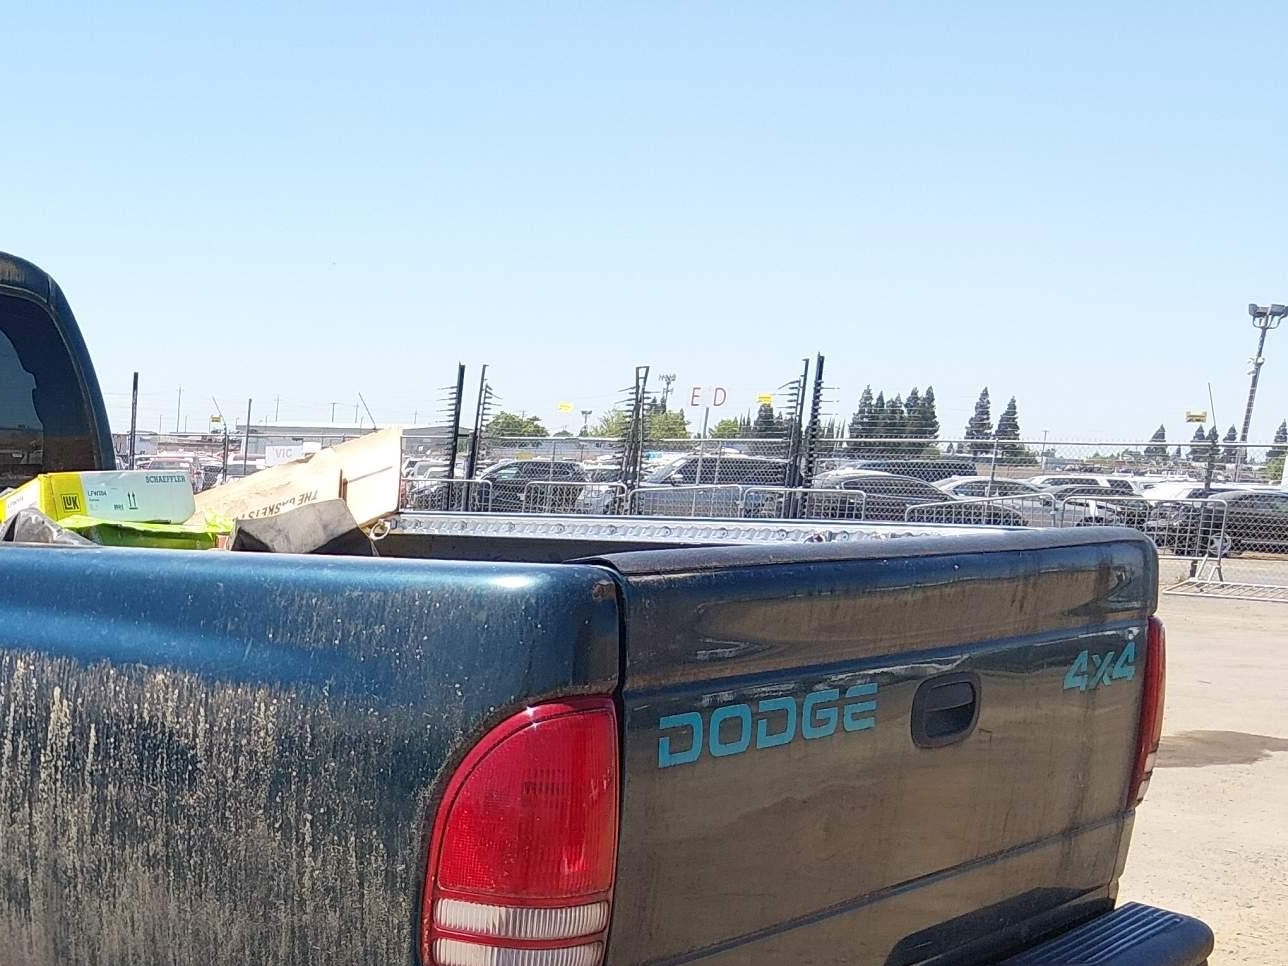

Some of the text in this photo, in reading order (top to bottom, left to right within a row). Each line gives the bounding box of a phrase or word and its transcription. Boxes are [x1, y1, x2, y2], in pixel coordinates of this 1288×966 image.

[691, 387, 727, 407] E D
[145, 475, 186, 484] SCHAEFFLER
[299, 490, 318, 502] THE
[657, 682, 879, 768] DODGE
